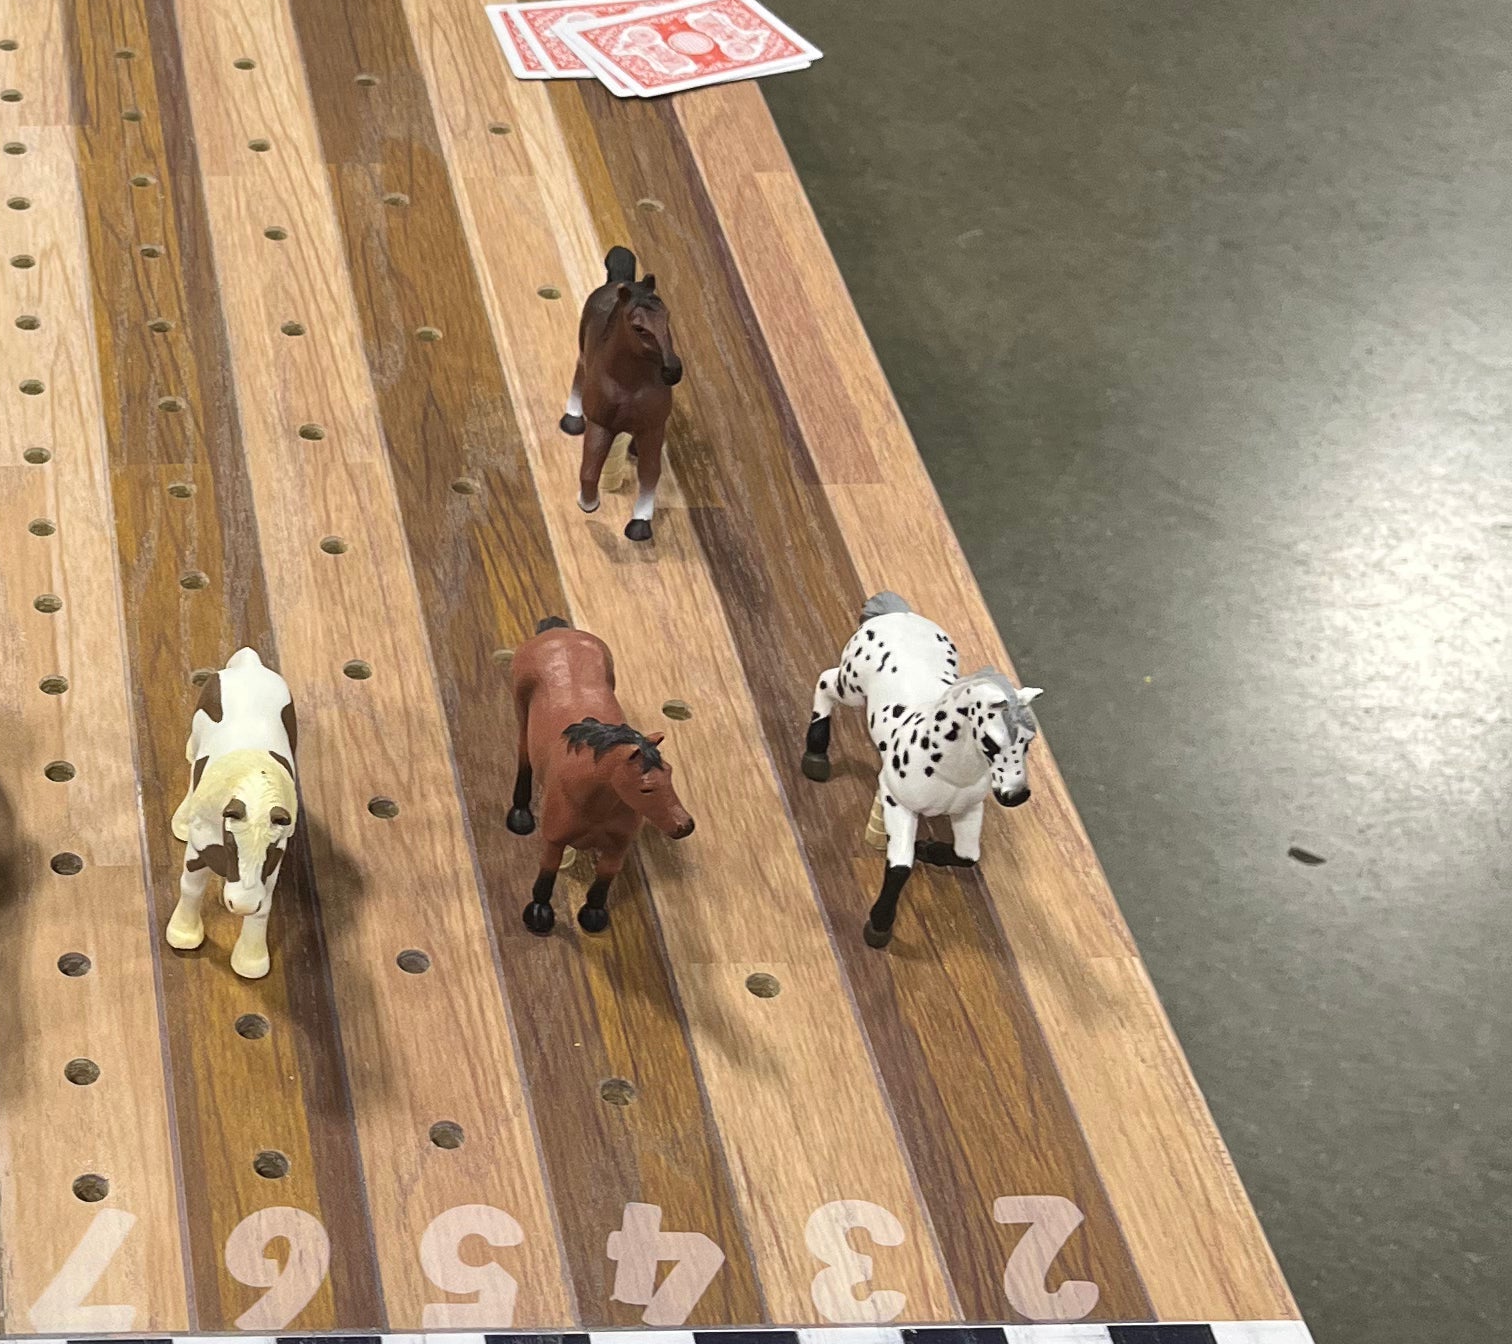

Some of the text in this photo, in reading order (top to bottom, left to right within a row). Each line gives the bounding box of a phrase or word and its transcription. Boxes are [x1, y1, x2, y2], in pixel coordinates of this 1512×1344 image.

[28, 1207, 138, 1333] 7
[224, 1206, 331, 1331] 6
[418, 1203, 525, 1329] 5
[606, 1201, 726, 1326] 4
[805, 1199, 906, 1323] 3
[993, 1195, 1099, 1320] 2
